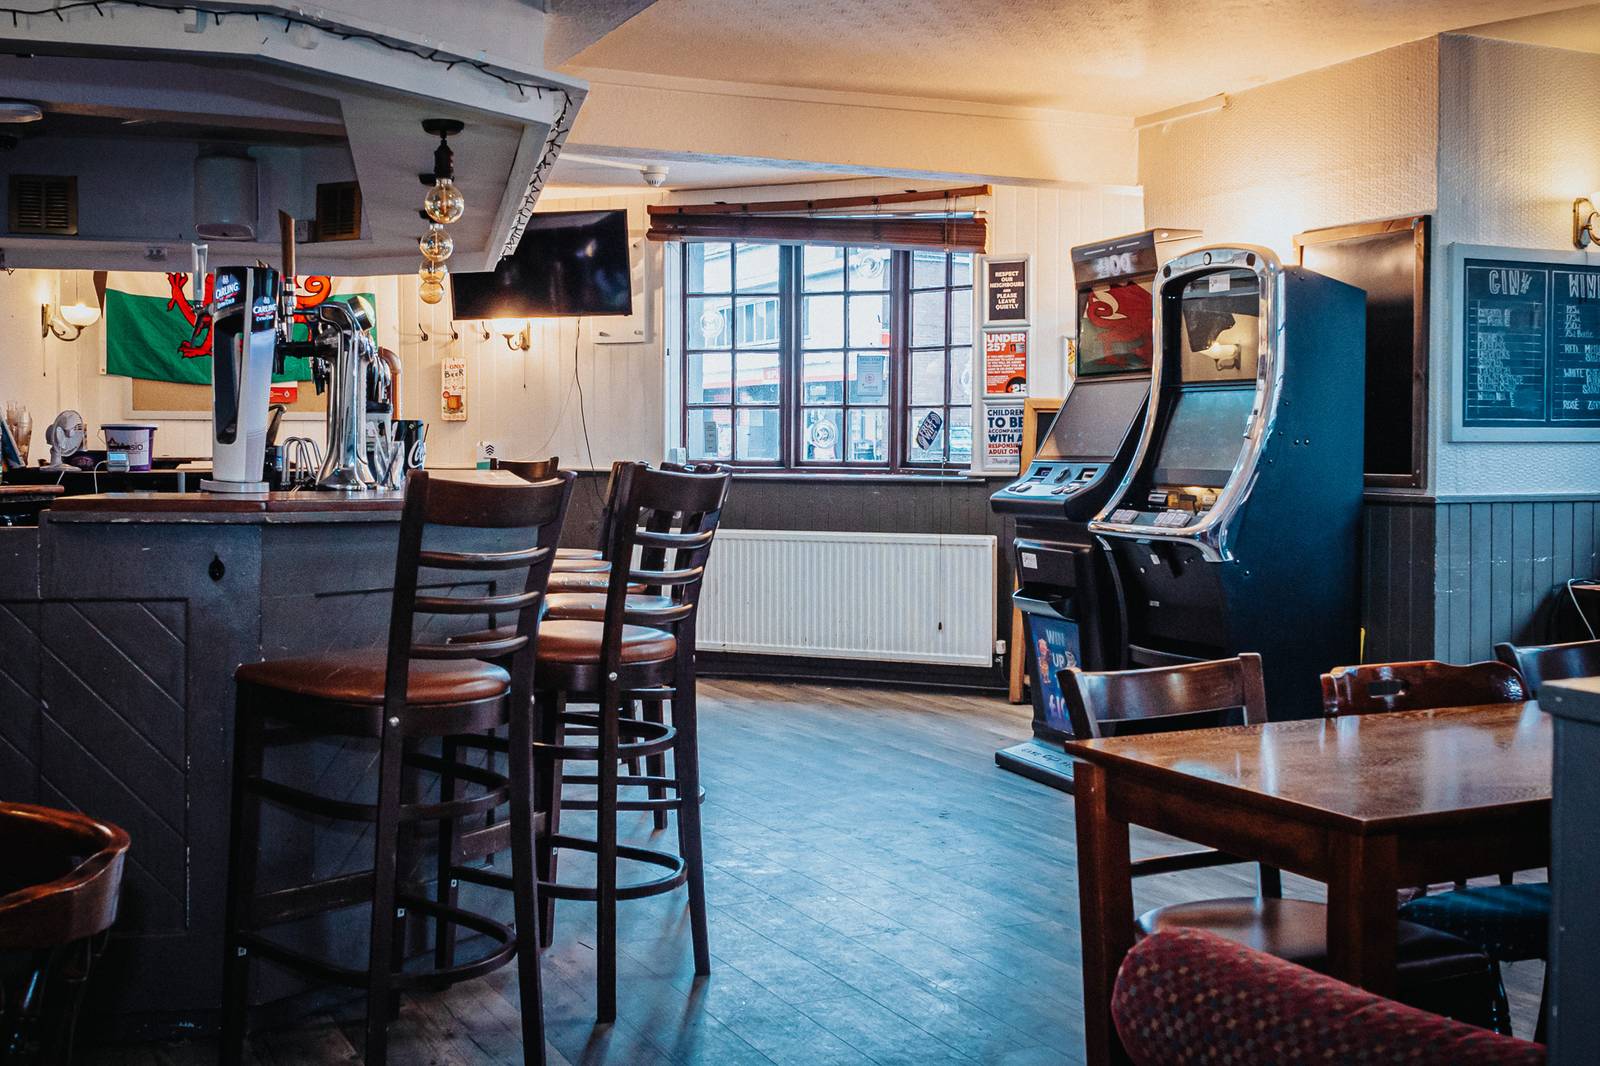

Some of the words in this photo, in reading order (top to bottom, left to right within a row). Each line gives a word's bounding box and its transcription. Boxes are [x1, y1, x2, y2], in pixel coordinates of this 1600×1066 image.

[1489, 270, 1520, 295] GIN
[1569, 274, 1600, 298] WIN
[216, 282, 239, 299] CARLING
[253, 304, 277, 314] CARLING
[987, 334, 1026, 342] UNDER
[987, 343, 1006, 351] 25?
[988, 417, 1006, 428] TO
[989, 434, 1014, 442] WITH
[1046, 629, 1064, 646] WIN
[1053, 654, 1064, 668] UP
